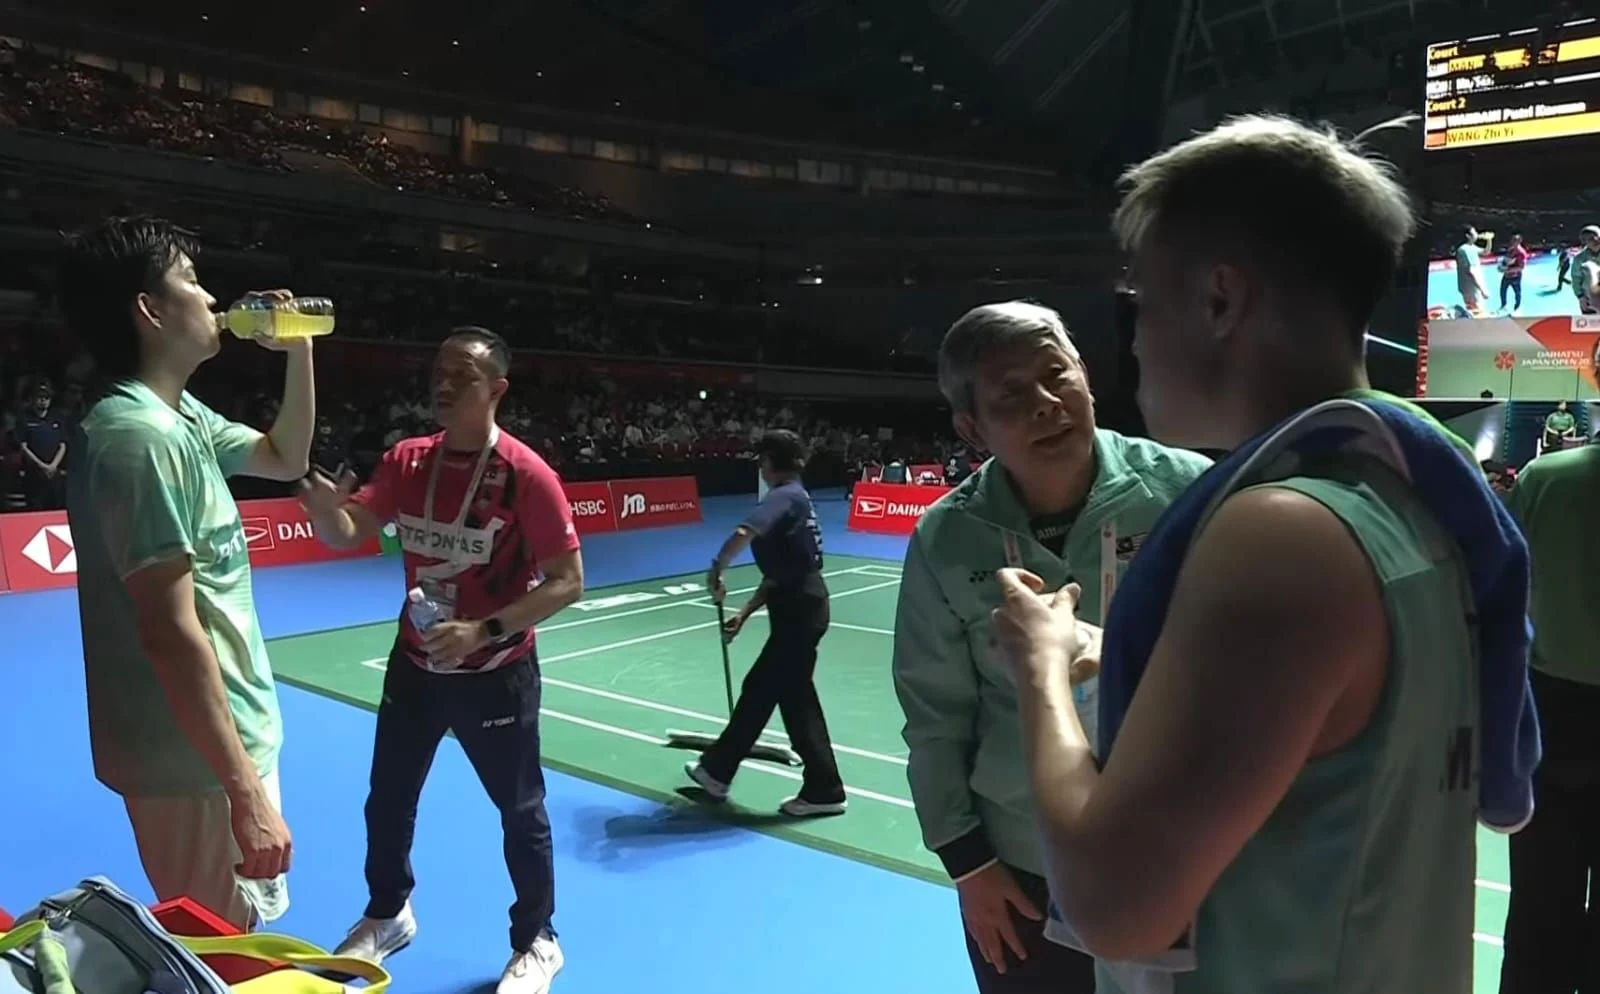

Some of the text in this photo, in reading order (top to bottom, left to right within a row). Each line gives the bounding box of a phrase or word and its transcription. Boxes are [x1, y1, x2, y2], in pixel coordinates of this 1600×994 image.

[1428, 99, 1457, 112] Court
[1447, 126, 1514, 143] WANG Zhi Yi
[568, 499, 607, 517] HSBC
[621, 493, 646, 518] JTB
[887, 502, 927, 517] DAIHA
